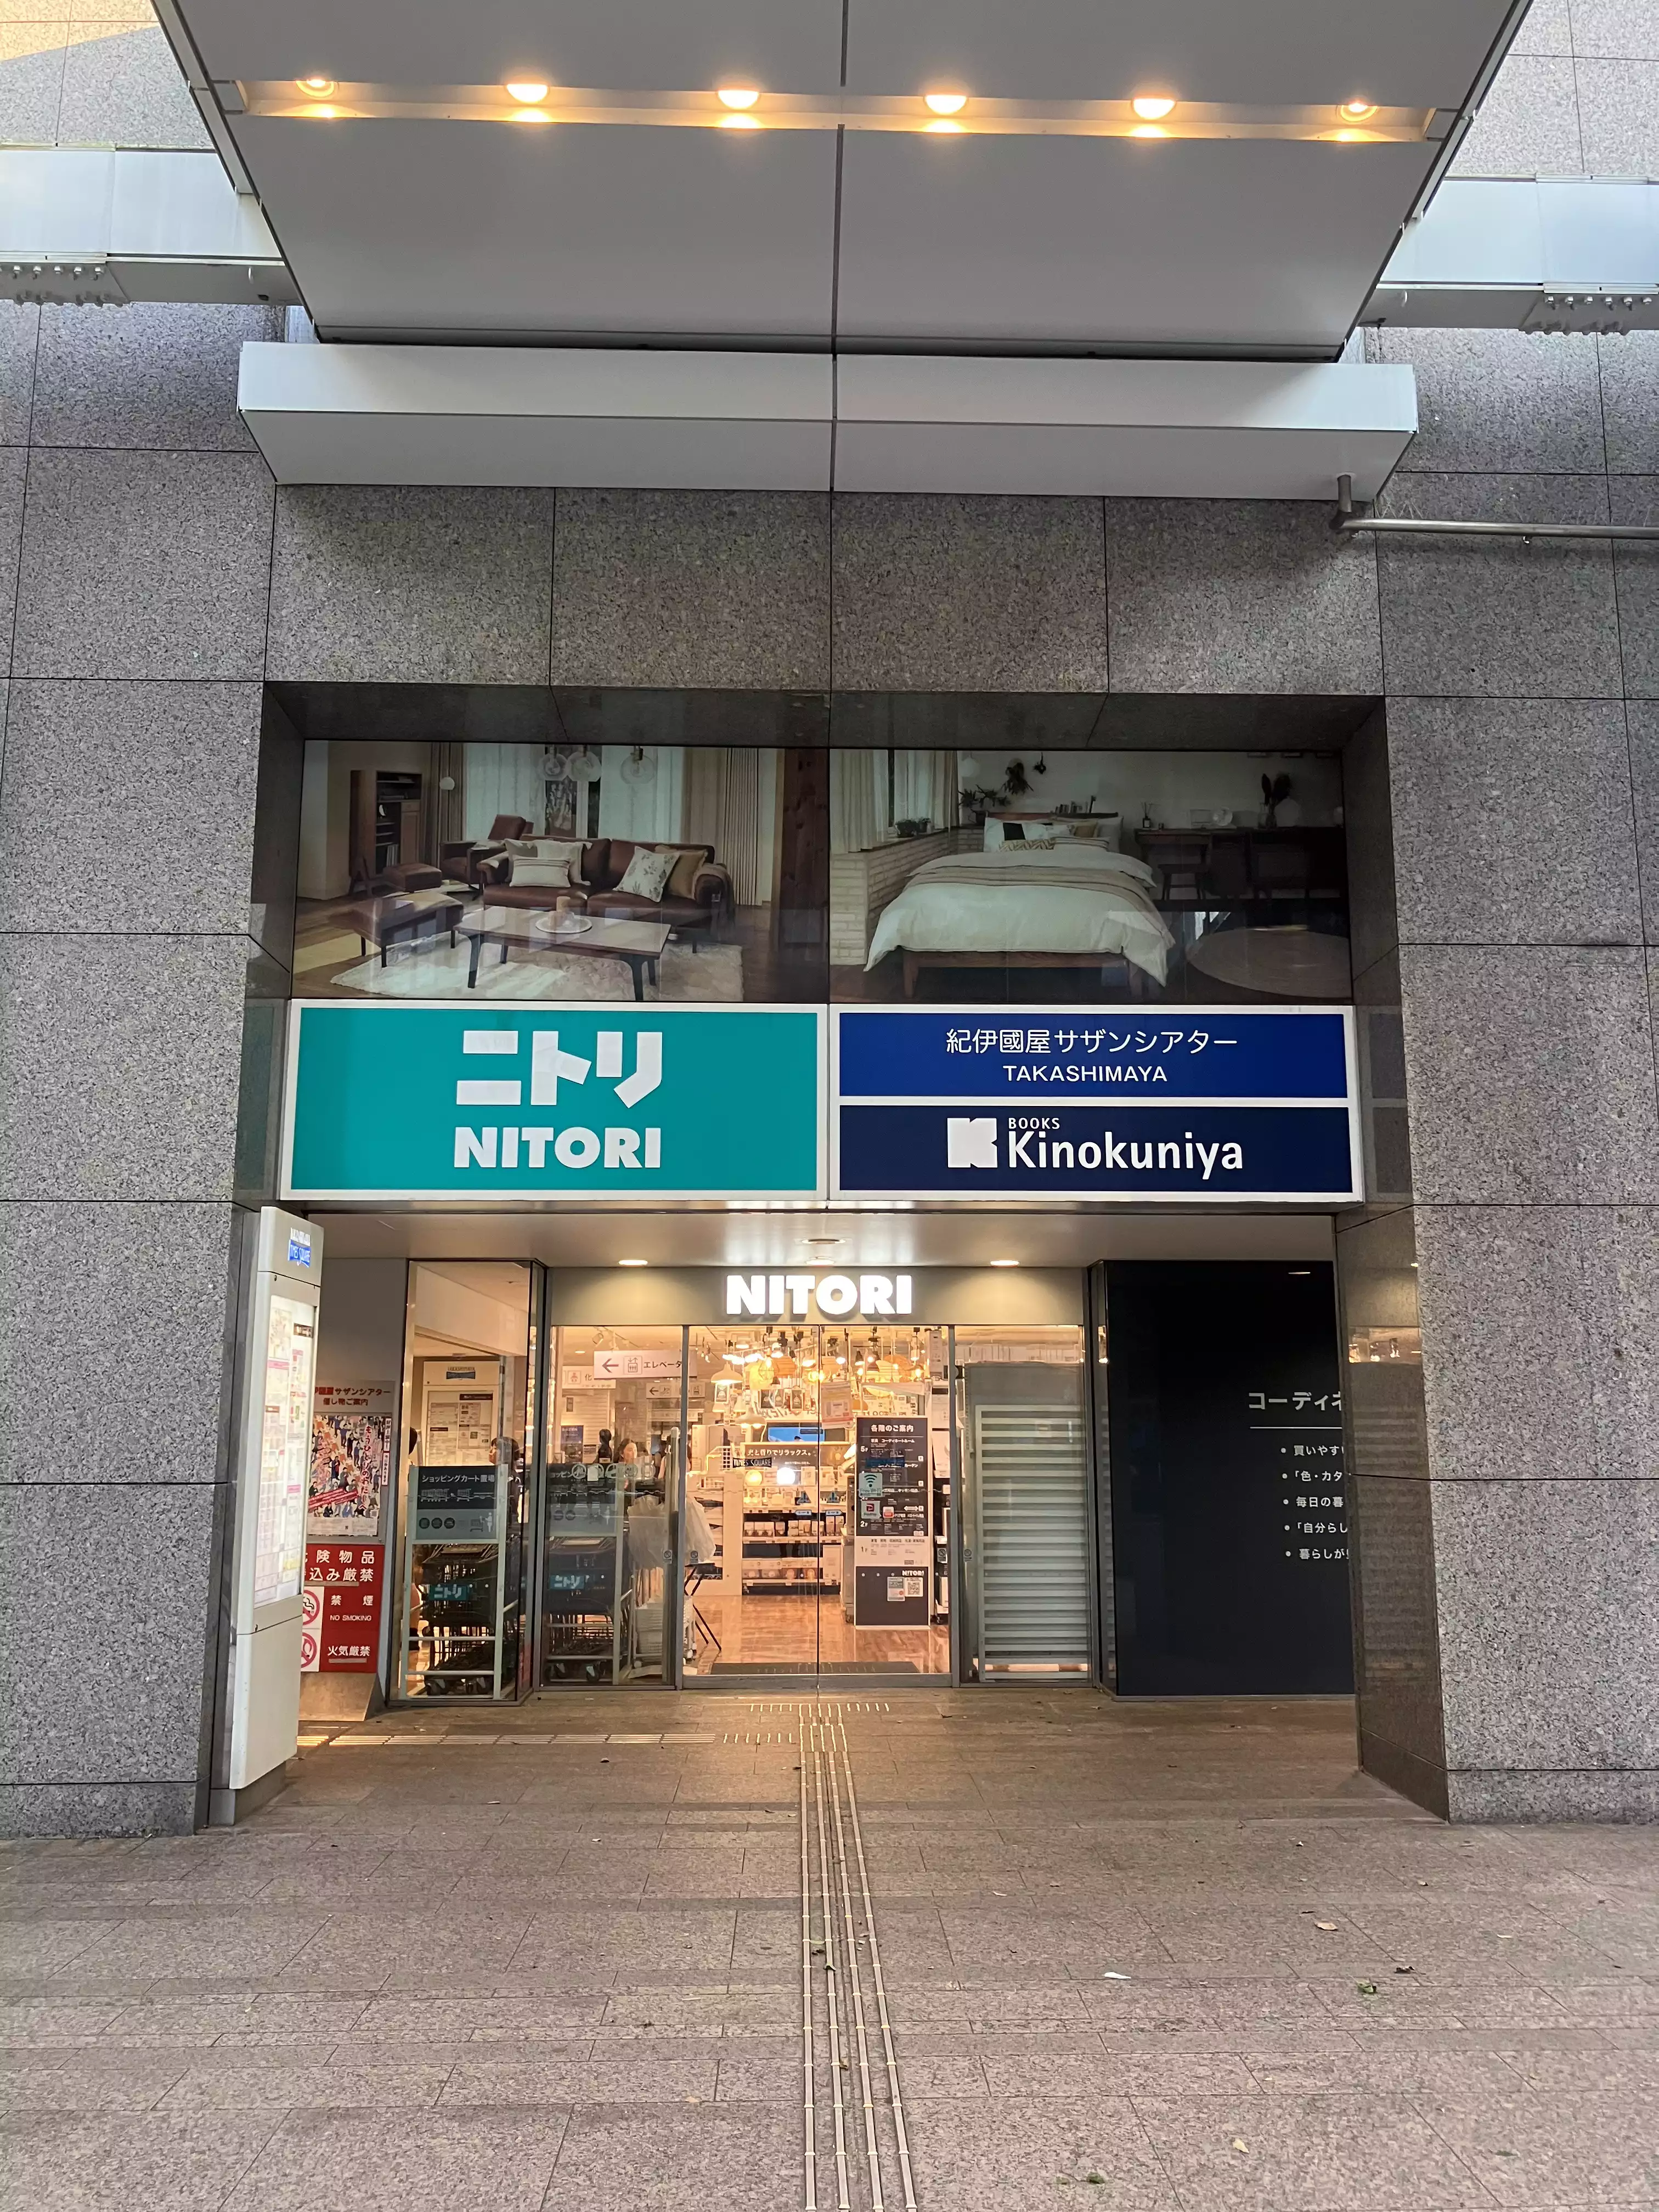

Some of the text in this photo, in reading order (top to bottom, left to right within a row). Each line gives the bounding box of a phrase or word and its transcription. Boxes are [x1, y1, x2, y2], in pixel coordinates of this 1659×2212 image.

[945, 1028, 1238, 1055] 紀伊國屋サザンシアター
[456, 1030, 663, 1109] ニトリ
[1003, 1065, 1168, 1083] TAKASHIMAYA
[1008, 1118, 1060, 1130] BOOKS
[454, 1127, 661, 1169] NITORI
[1008, 1132, 1244, 1180] Kinokuniya
[726, 1274, 912, 1315] NITORI
[1294, 1444, 1344, 1456] 買いやす
[304, 1549, 375, 1564] 険物品
[1299, 1548, 1350, 1560] 暮らしが
[304, 1567, 374, 1582] 込み厳禁
[328, 1645, 370, 1657] 火気厳禁
